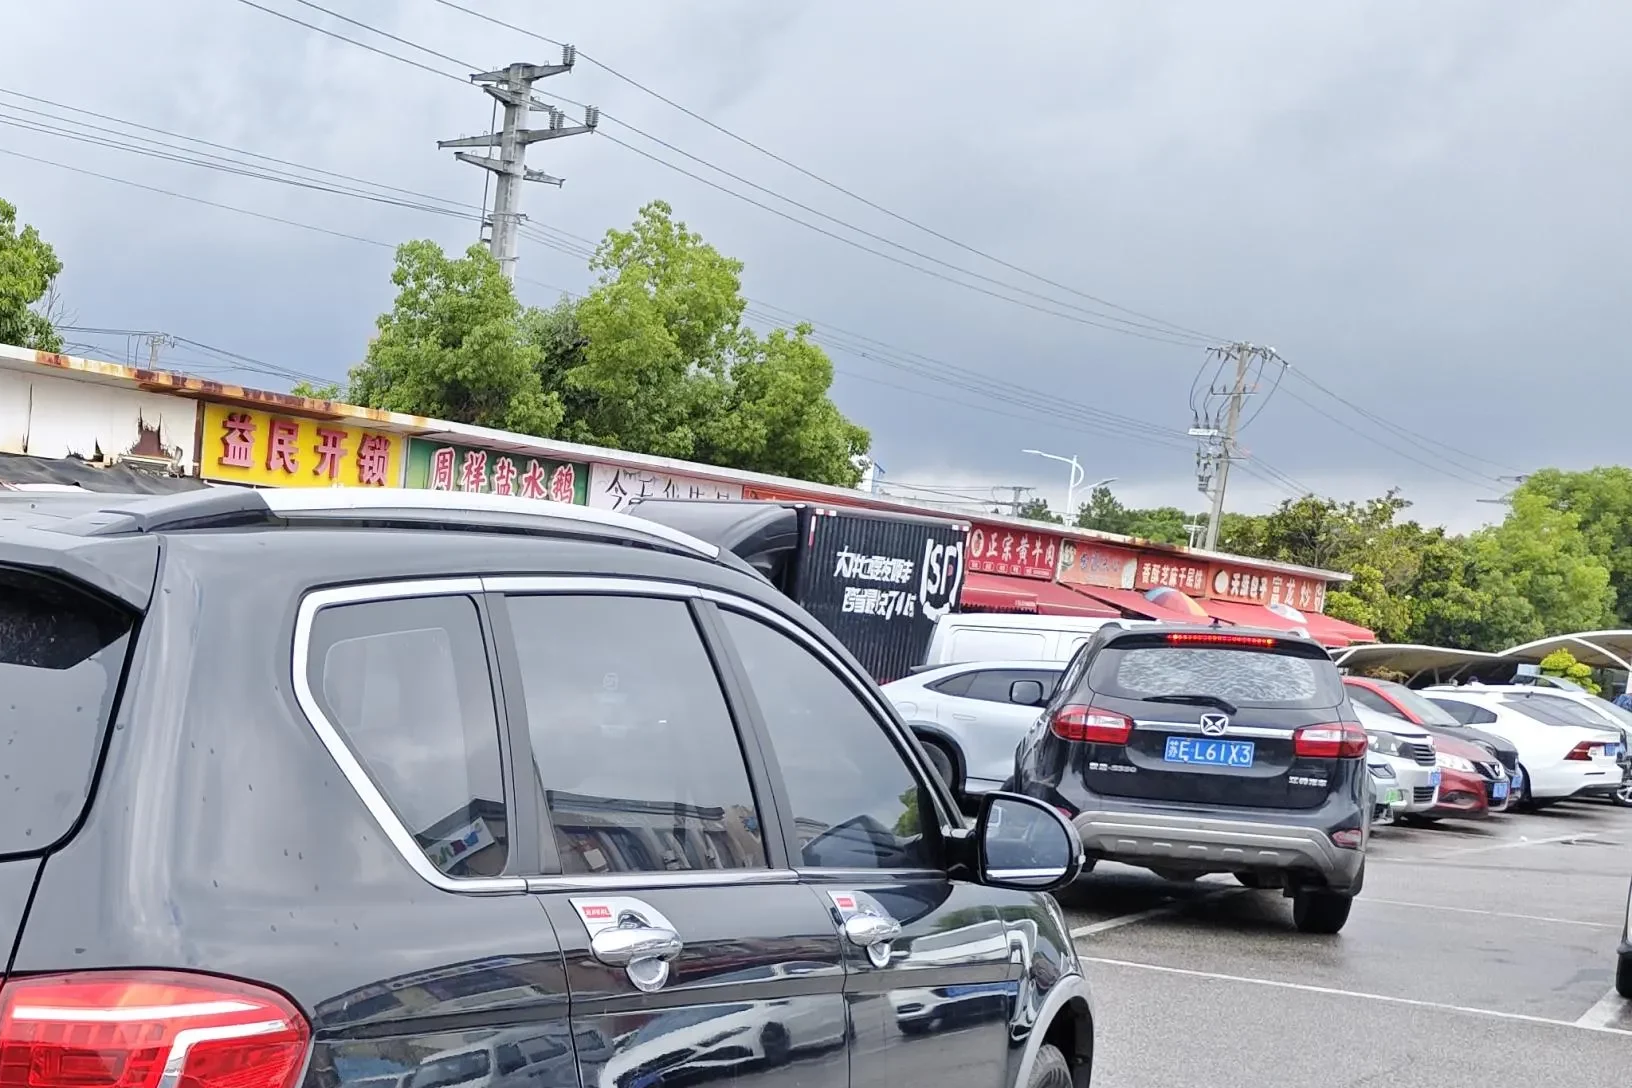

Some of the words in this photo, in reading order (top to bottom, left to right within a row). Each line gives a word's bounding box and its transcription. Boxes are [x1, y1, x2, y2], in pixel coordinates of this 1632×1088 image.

[218, 412, 391, 487] 益民开锁
[432, 447, 575, 504] 周祥盐水鹅
[986, 532, 1056, 569] 正宗黄牛肉
